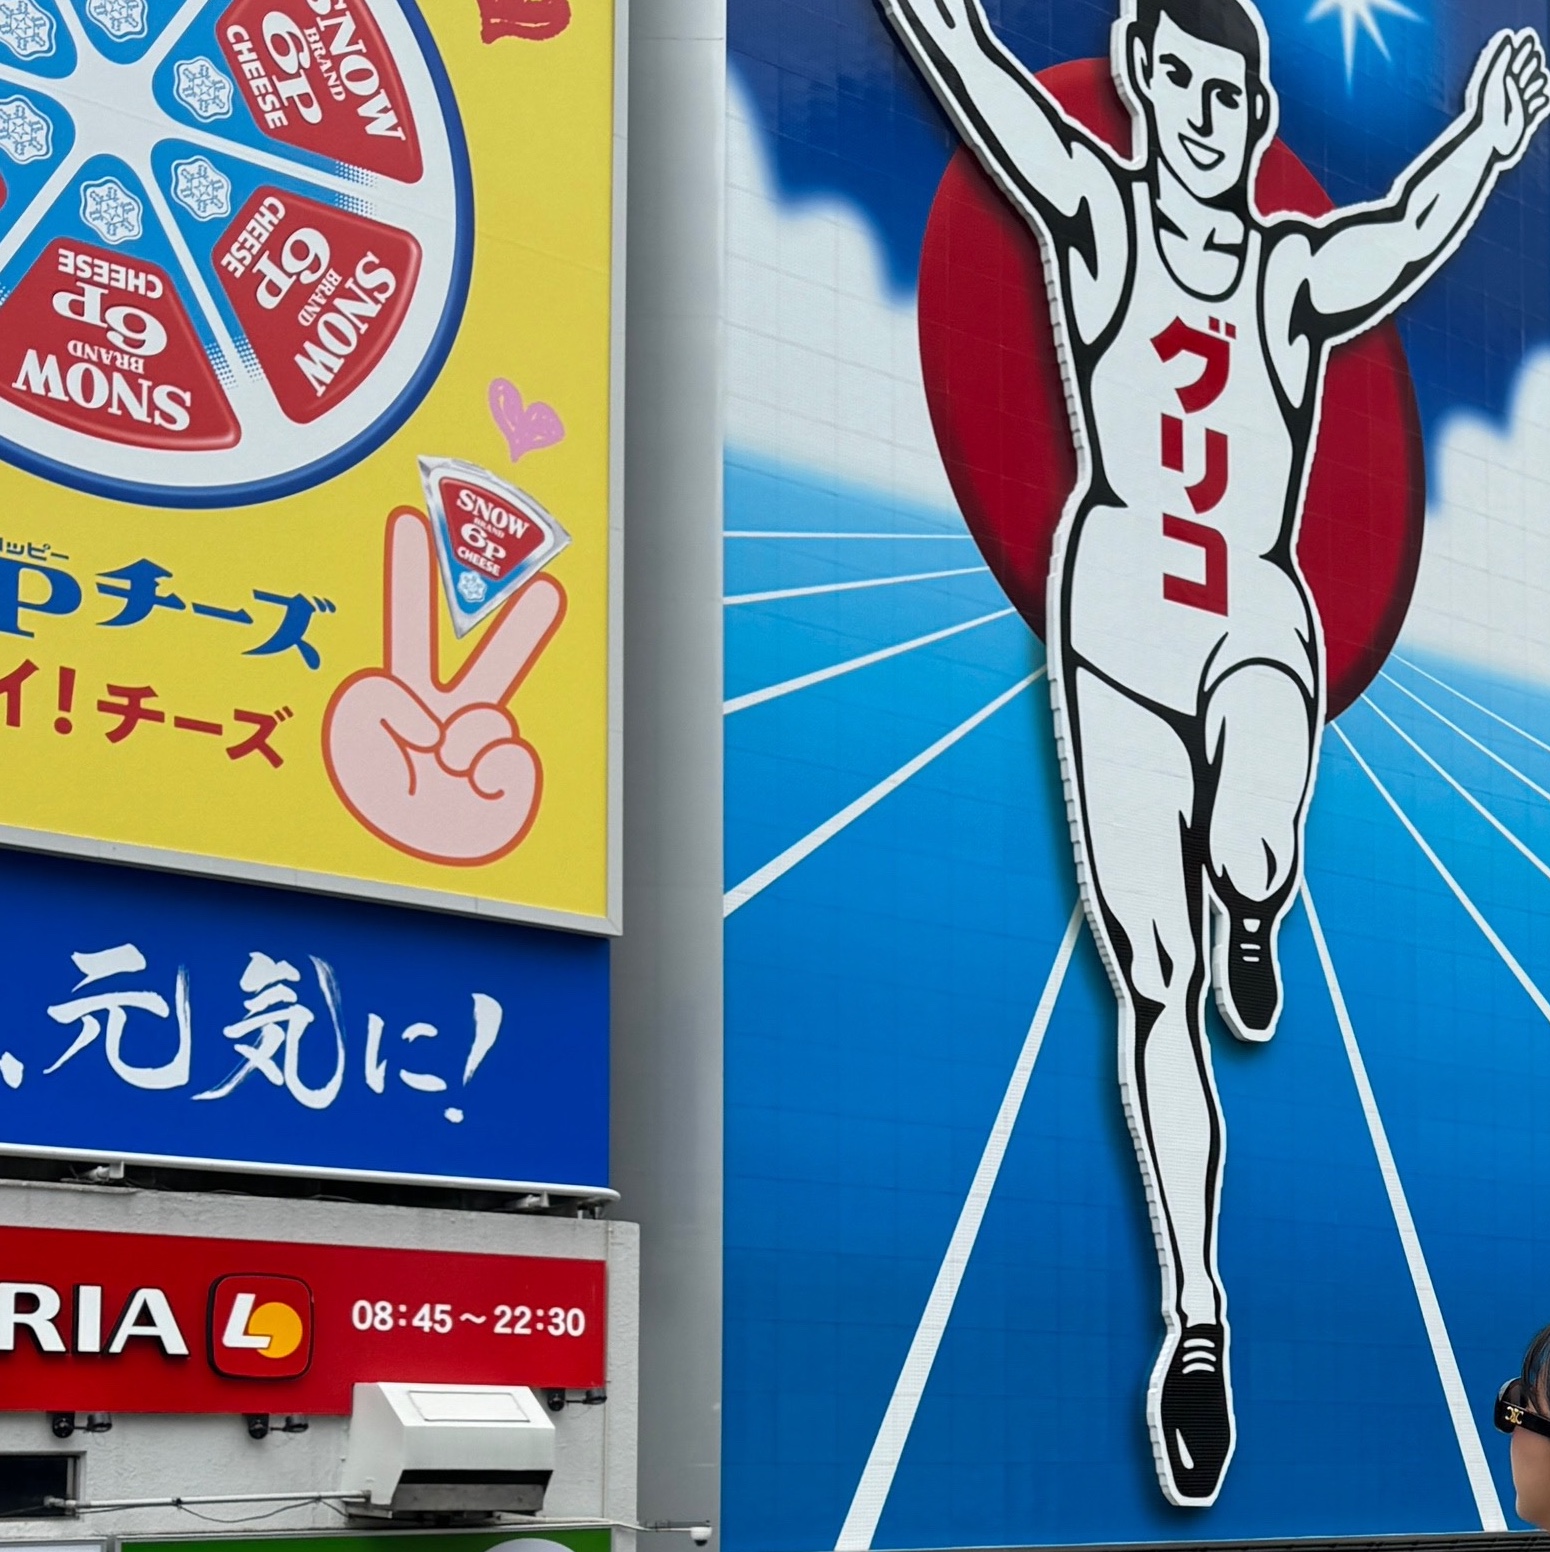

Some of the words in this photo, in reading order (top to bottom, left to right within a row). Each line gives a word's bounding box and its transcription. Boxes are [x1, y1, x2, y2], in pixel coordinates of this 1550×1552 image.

[226, 25, 289, 130] CHEESE
[261, 11, 323, 125] 6P
[303, 28, 346, 102] BRAND
[57, 247, 164, 298] CHEESE
[221, 197, 285, 279] CHEESE
[255, 227, 331, 310] 6P
[52, 283, 168, 357] 6P
[294, 251, 395, 397] SNOW
[298, 269, 340, 327] BRAND
[12, 349, 192, 432] SNOW
[67, 340, 145, 374] BRAND
[1150, 315, 1236, 617] グリコ
[0, 537, 69, 561] ッピー
[456, 489, 530, 539] SNOW
[461, 523, 506, 561] 6P
[457, 546, 501, 577] CHEESE
